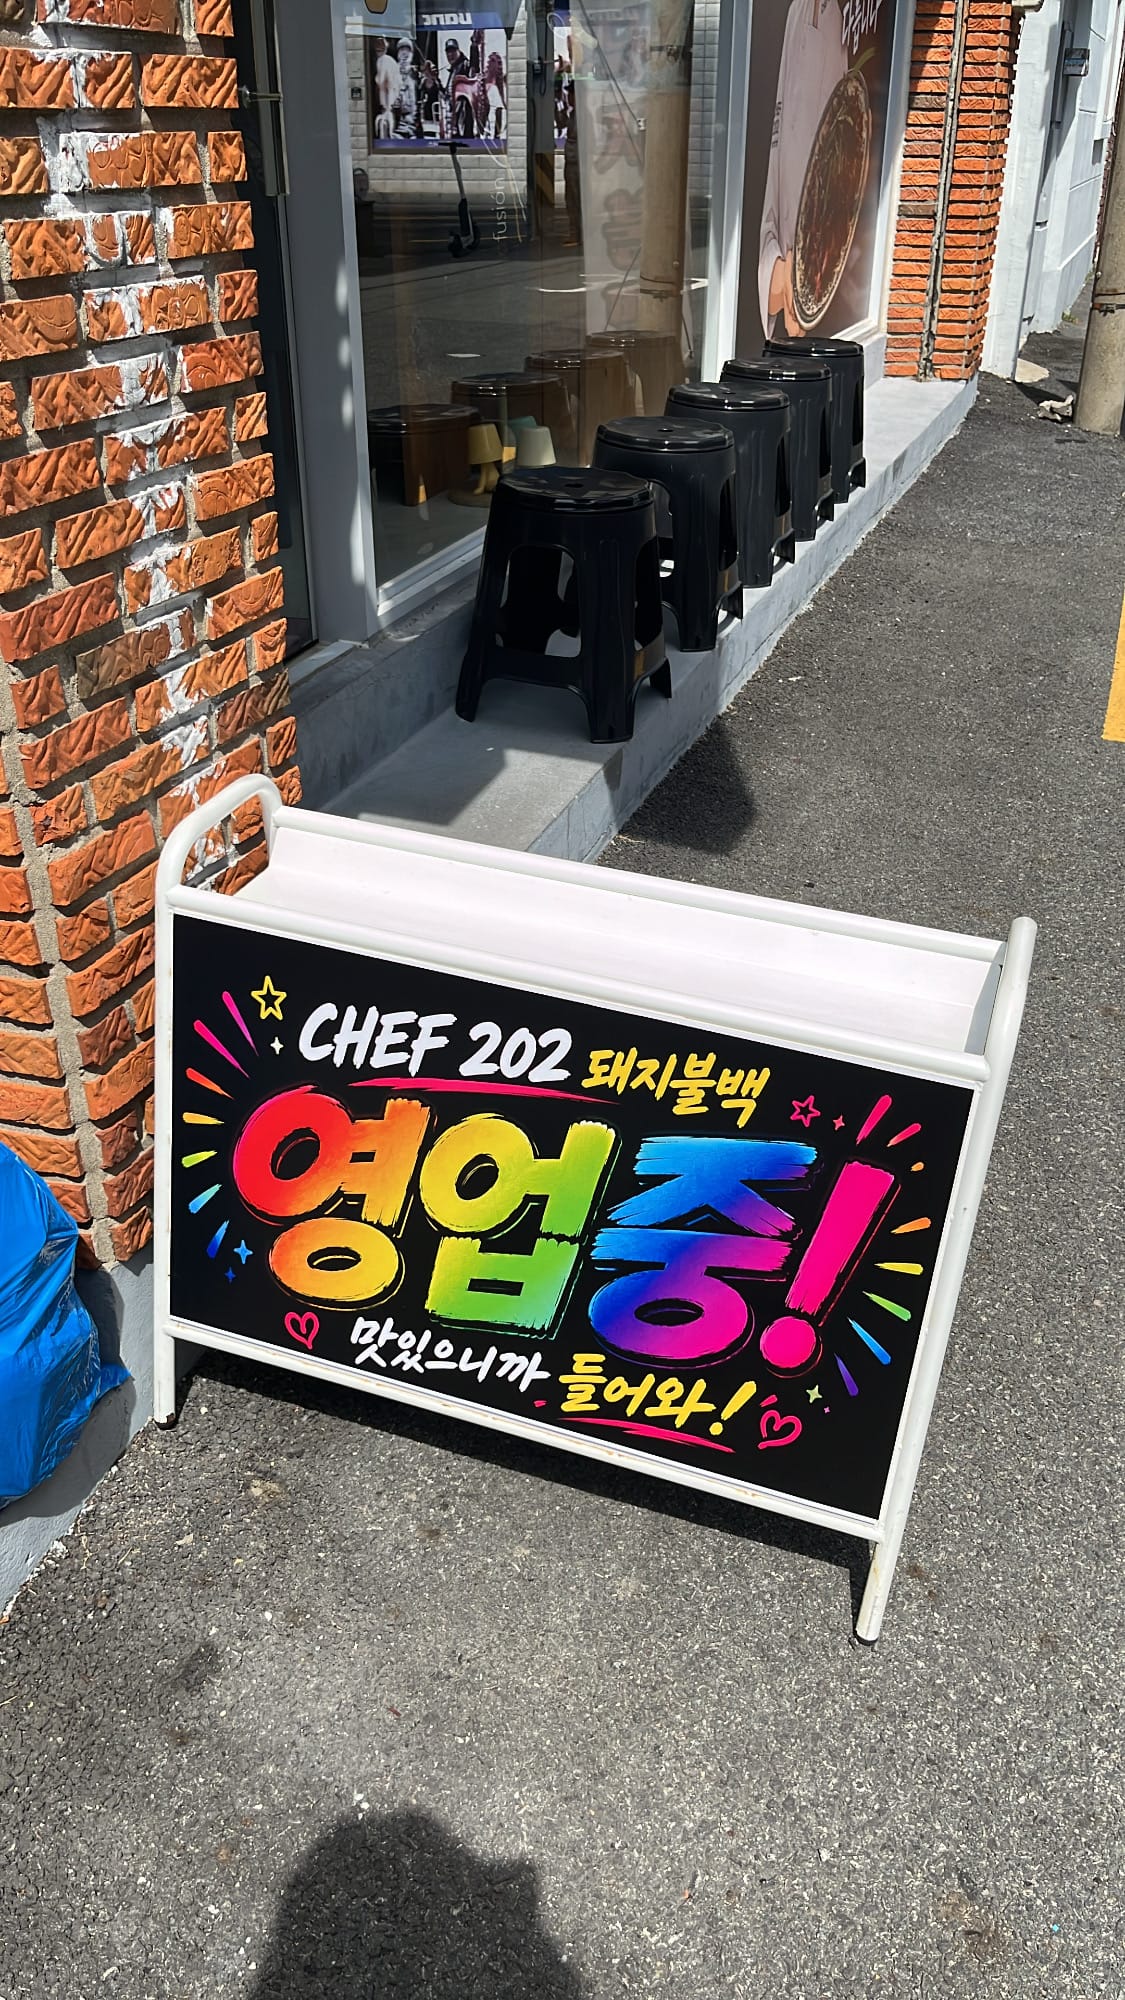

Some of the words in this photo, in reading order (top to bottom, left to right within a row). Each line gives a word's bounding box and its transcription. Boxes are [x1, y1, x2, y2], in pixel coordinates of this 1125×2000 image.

[299, 1002, 457, 1077] CHEF
[459, 1021, 573, 1083] 202
[581, 1046, 771, 1128] 돼지불백
[232, 1085, 897, 1374] 영업중!
[350, 1316, 551, 1392] 맛있으니까
[559, 1352, 758, 1436] 들어와!
